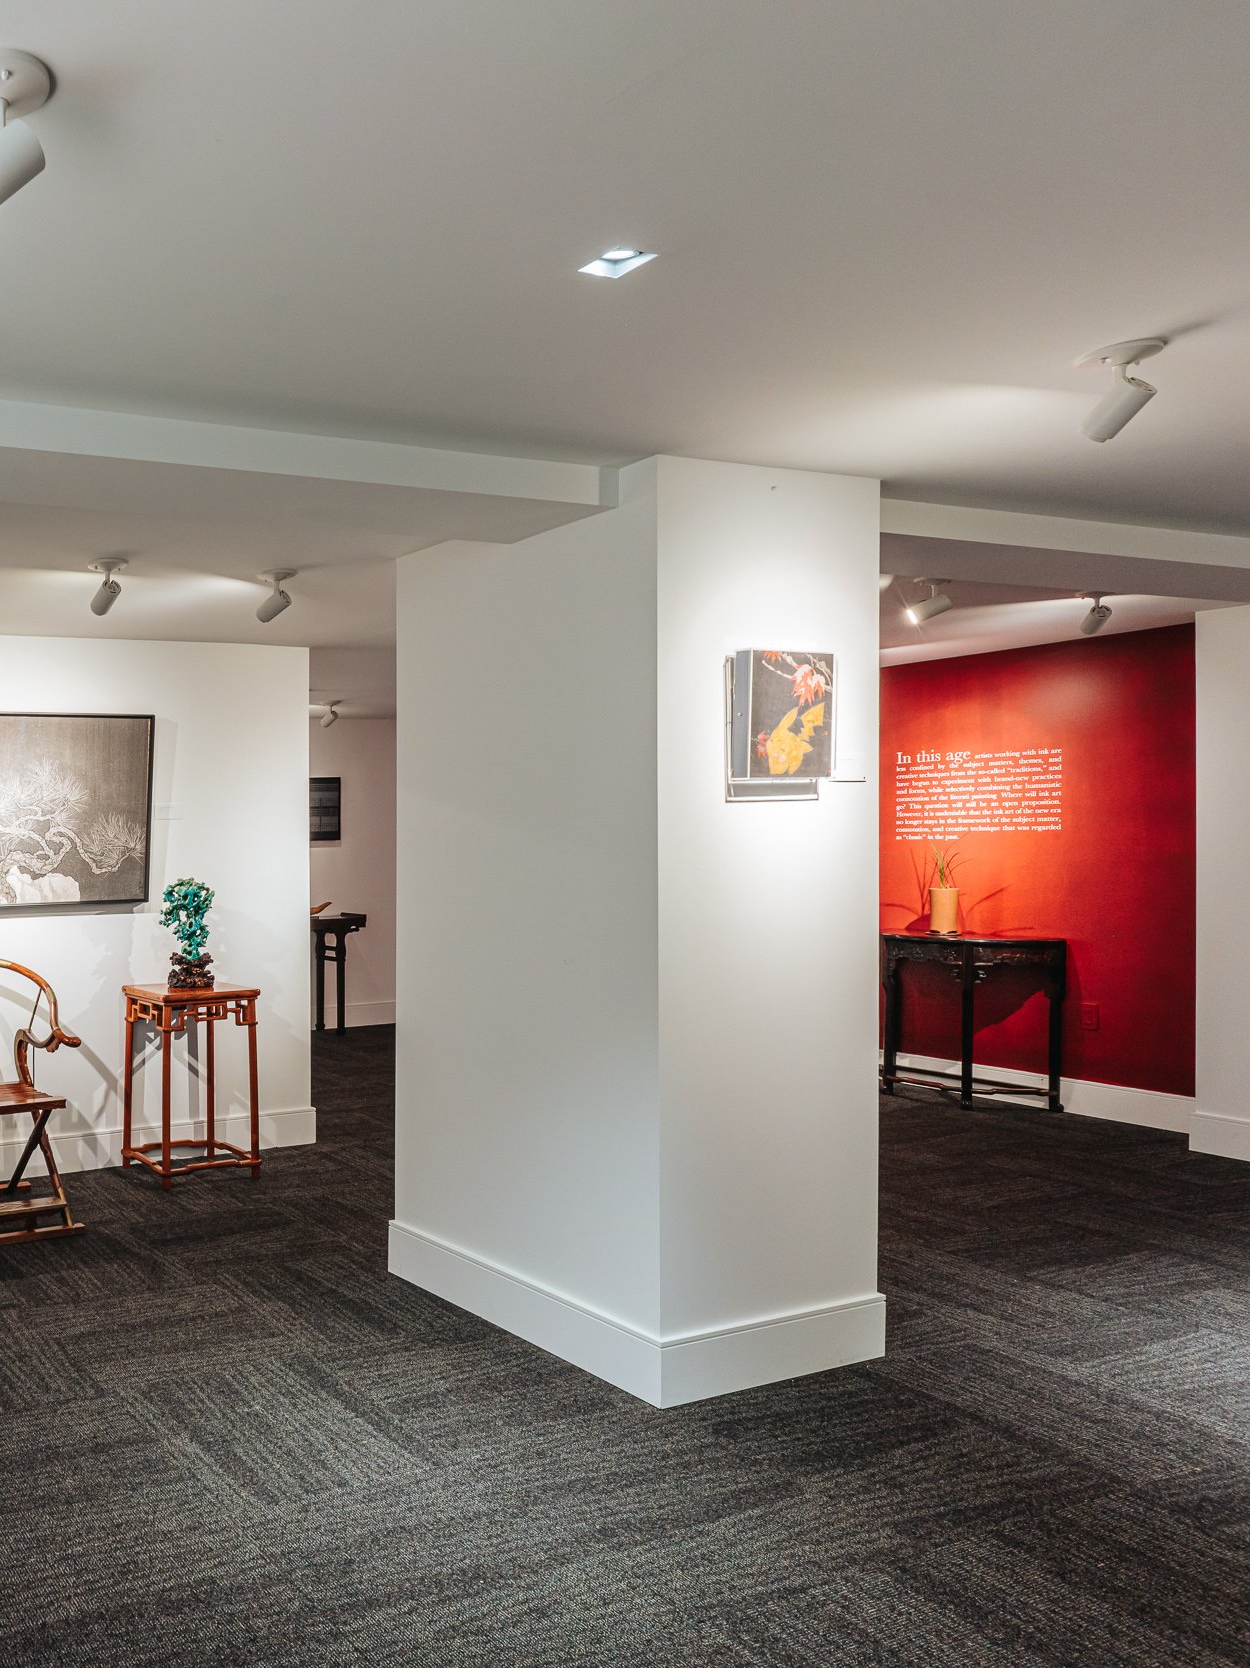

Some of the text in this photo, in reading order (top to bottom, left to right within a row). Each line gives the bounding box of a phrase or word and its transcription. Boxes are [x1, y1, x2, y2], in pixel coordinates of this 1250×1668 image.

[896, 752, 911, 764] In
[917, 749, 941, 762] this
[946, 751, 971, 764] age
[1022, 799, 1061, 807] proposition.
